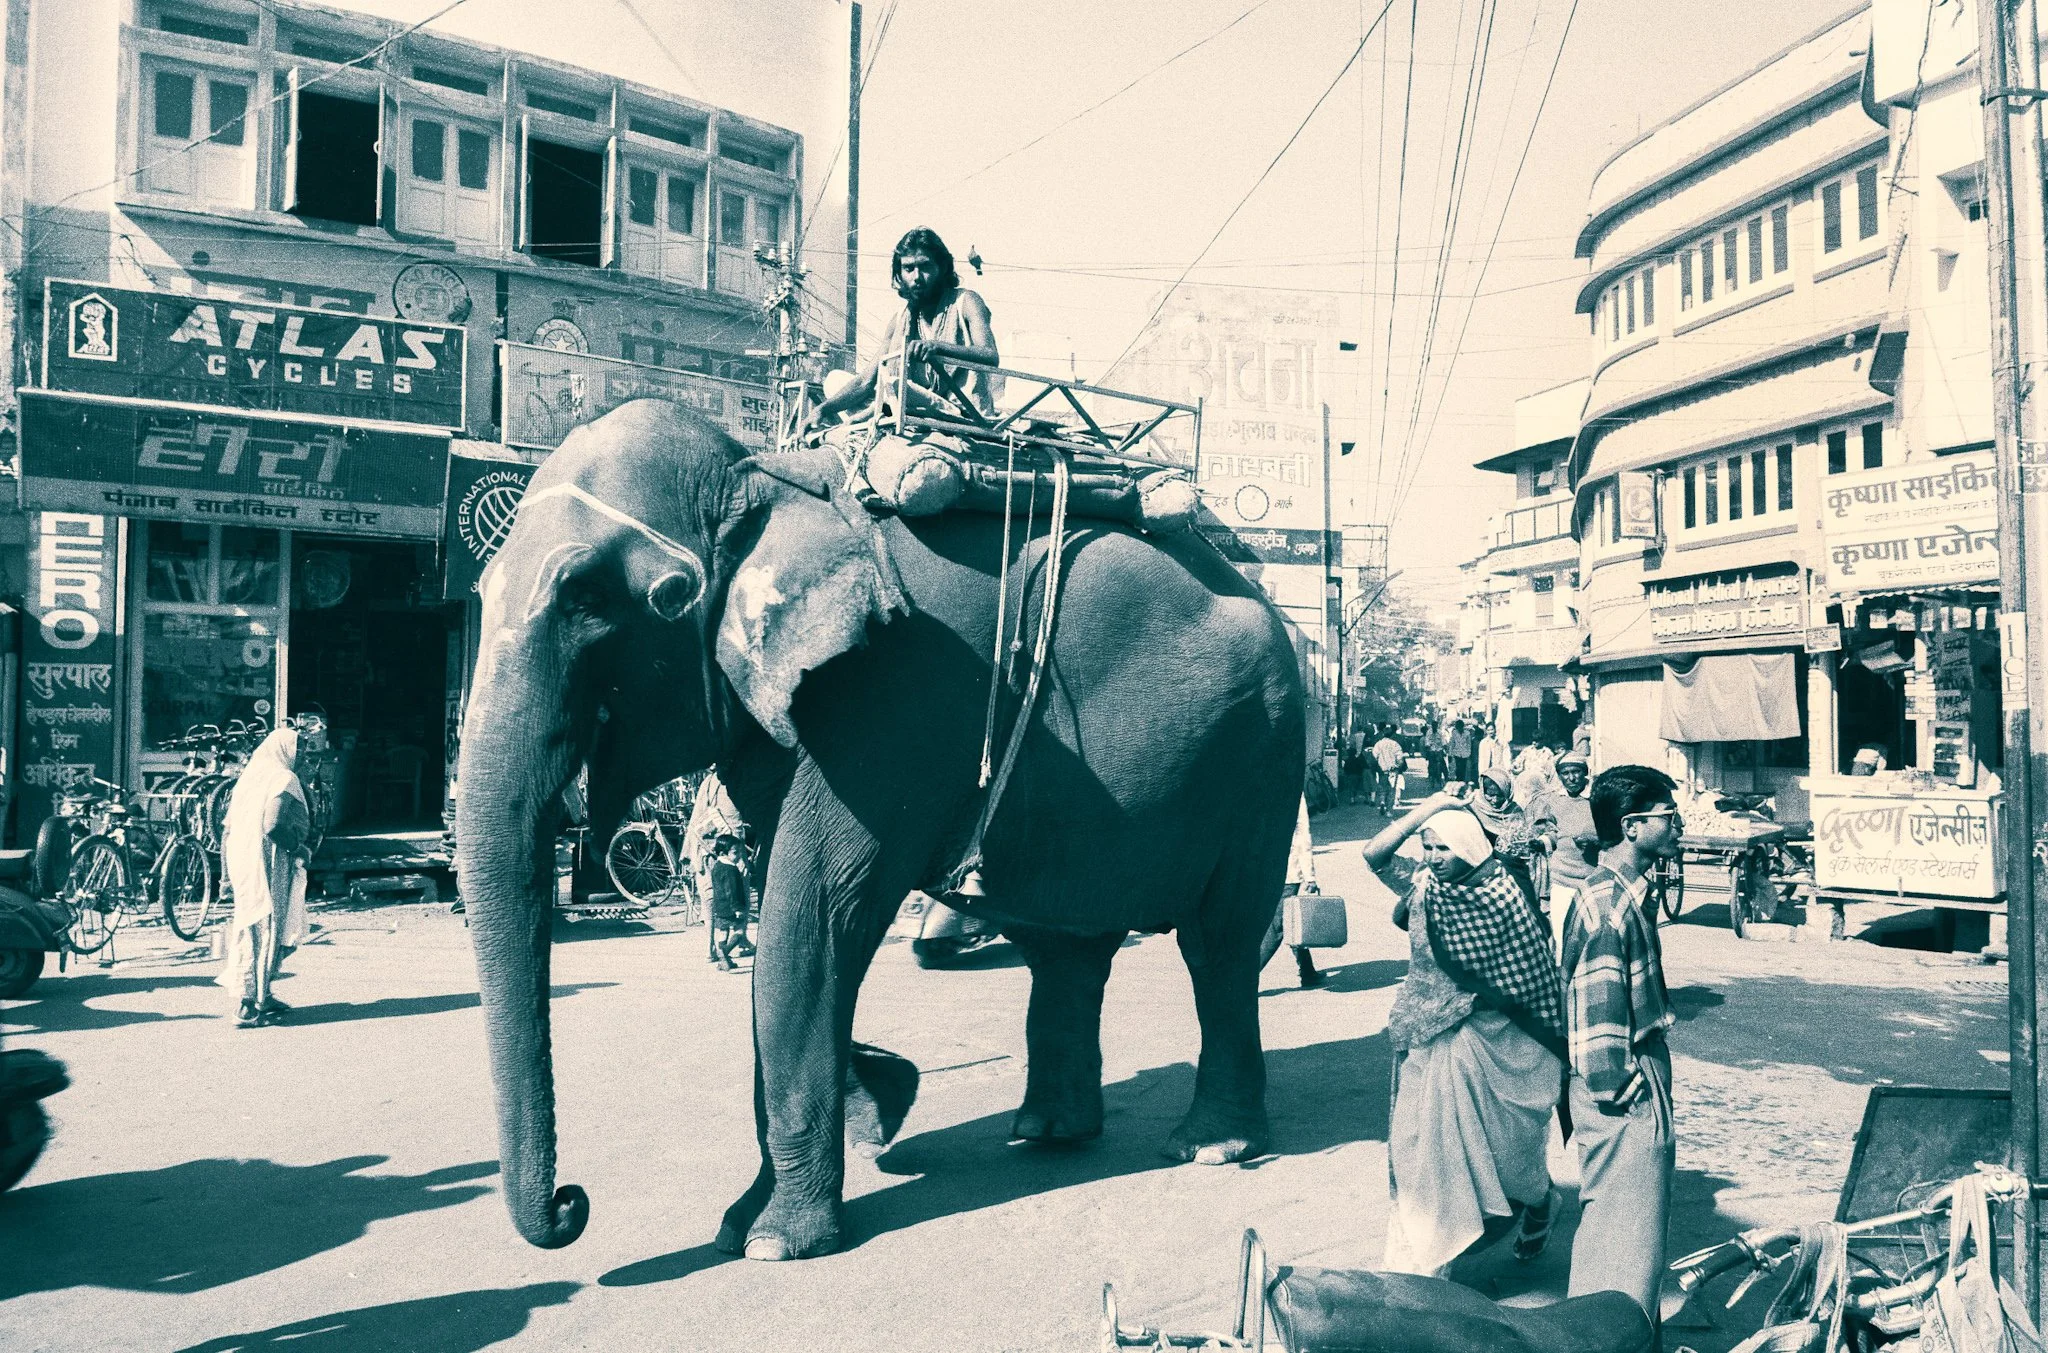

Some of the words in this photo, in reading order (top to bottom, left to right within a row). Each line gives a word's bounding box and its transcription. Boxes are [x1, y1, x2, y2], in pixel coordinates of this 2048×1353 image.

[170, 305, 445, 370] ATLAS
[208, 355, 411, 394] CYCLES
[138, 423, 351, 483] हीरो
[102, 489, 180, 511] पंजाब
[319, 504, 381, 525] स्टोर
[458, 471, 527, 554] INTERNATIONAL
[1827, 480, 1898, 518] कृष्णा
[1831, 538, 1909, 576] कृष्णा
[1650, 581, 1695, 610] National
[1698, 575, 1741, 605] Medical
[1744, 572, 1800, 605] Agencies
[28, 662, 113, 699] सुरपाल
[1820, 805, 1909, 853] कृष्णा
